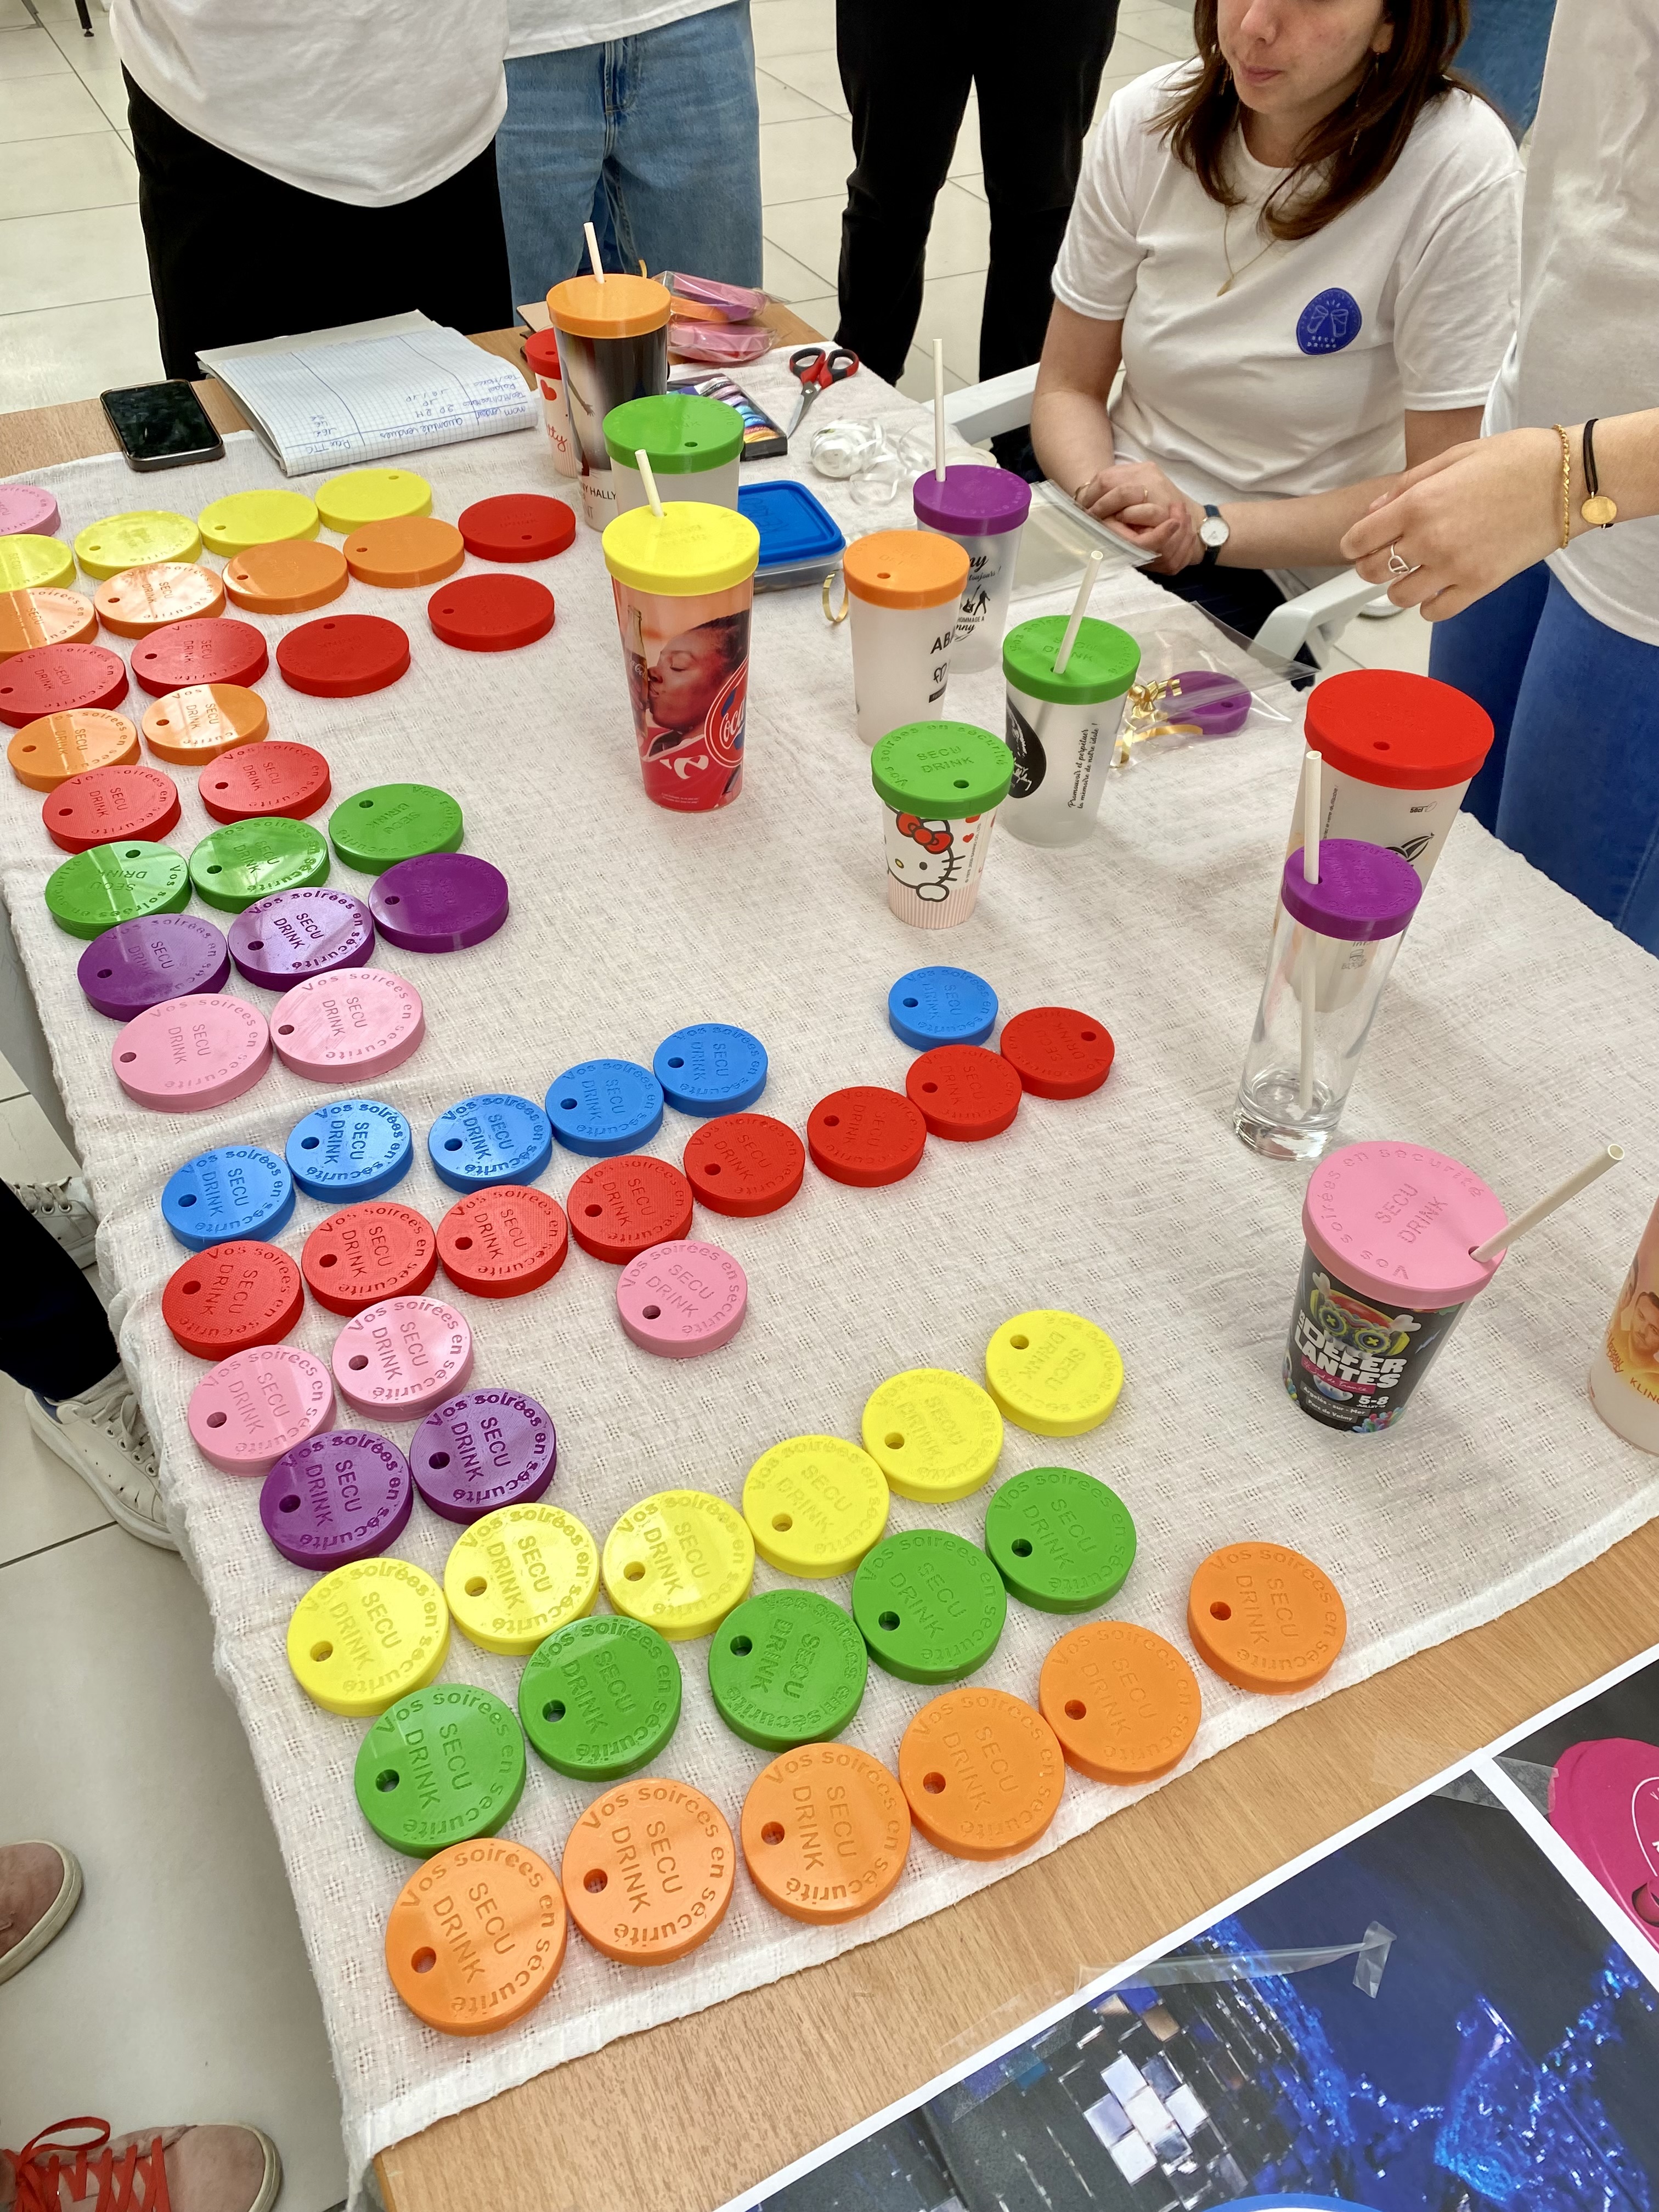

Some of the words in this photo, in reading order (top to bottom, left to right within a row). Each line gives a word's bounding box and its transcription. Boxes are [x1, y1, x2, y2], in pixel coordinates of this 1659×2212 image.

[306, 443, 329, 454] TTC
[956, 623, 976, 634] nny
[186, 704, 200, 730] DRINK
[206, 703, 219, 725] SECU
[242, 764, 263, 792] DRINK
[263, 762, 282, 785] SECU
[917, 747, 961, 761] SECU
[921, 757, 974, 773] DRINK
[1067, 770, 1081, 808] Promouvoir
[1079, 729, 1088, 760] perpétuer
[1080, 774, 1090, 800] mémoire
[1090, 728, 1099, 744] idole
[90, 790, 108, 818] DRINK
[110, 787, 128, 811] SECU
[273, 917, 304, 949] DRINK
[296, 912, 323, 939] SECU
[323, 1000, 346, 1037] DRINK
[347, 997, 368, 1029] SECU
[168, 1027, 187, 1065] DRINK
[193, 1024, 211, 1057] SECU
[314, 1104, 352, 1120] Vos
[383, 1143, 400, 1160] en
[326, 1120, 345, 1165] DRINK
[353, 1122, 370, 1160] SECU
[1343, 1153, 1368, 1167] en
[202, 1171, 223, 1217] DRINK
[228, 1168, 250, 1207] SECU
[1375, 1183, 1418, 1223] SECU
[1397, 1198, 1447, 1244] DRINK
[342, 1230, 367, 1278] DRINK
[370, 1226, 393, 1266] SECU
[1361, 1250, 1409, 1280] Vos
[646, 1276, 699, 1318] DRINK
[668, 1264, 715, 1301] SECU
[348, 1306, 386, 1333] Vos
[450, 1334, 463, 1355] en
[372, 1327, 403, 1380] DRINK
[400, 1321, 428, 1367] SECU
[1295, 1325, 1401, 1389] LANTES
[228, 1382, 264, 1434] DRINK
[257, 1372, 290, 1418] SECU
[1304, 1386, 1327, 1406] Argelès
[1308, 1399, 1321, 1410] Parc
[1332, 1411, 1353, 1421] Valmy
[1358, 1395, 1389, 1405] 5-8
[426, 1398, 467, 1427] Vos
[533, 1433, 546, 1454] en
[481, 1417, 511, 1468] SECU
[450, 1421, 484, 1482] DRINK
[460, 1516, 503, 1550] Vos
[576, 1551, 589, 1577] en
[1023, 1505, 1074, 1570] DRINK
[1051, 1499, 1097, 1553] SECU
[486, 1541, 524, 1609] DRINK
[518, 1536, 552, 1593] SECU
[889, 1572, 944, 1638] DRINK
[917, 1562, 966, 1618] SECU
[1237, 1575, 1269, 1645] DRINK
[1267, 1578, 1297, 1639] SECU
[531, 1633, 574, 1670] Vos
[657, 1664, 672, 1694] en
[593, 1651, 635, 1713] SECU
[561, 1661, 608, 1734] DRINK
[405, 1731, 441, 1810] DRINK
[439, 1723, 471, 1791] SECU
[765, 1754, 812, 1785] Vos
[884, 1819, 900, 1851] en
[827, 1786, 856, 1858] SECU
[581, 1792, 629, 1829] Vos
[711, 1846, 725, 1879] en
[793, 1785, 824, 1870] DRINK
[612, 1826, 651, 1912] DRINK
[646, 1821, 682, 1894] SECU
[400, 1864, 448, 1909] Vos
[539, 1894, 555, 1928] en
[469, 1882, 515, 1955] SECU
[433, 1894, 485, 1983] DRINK
